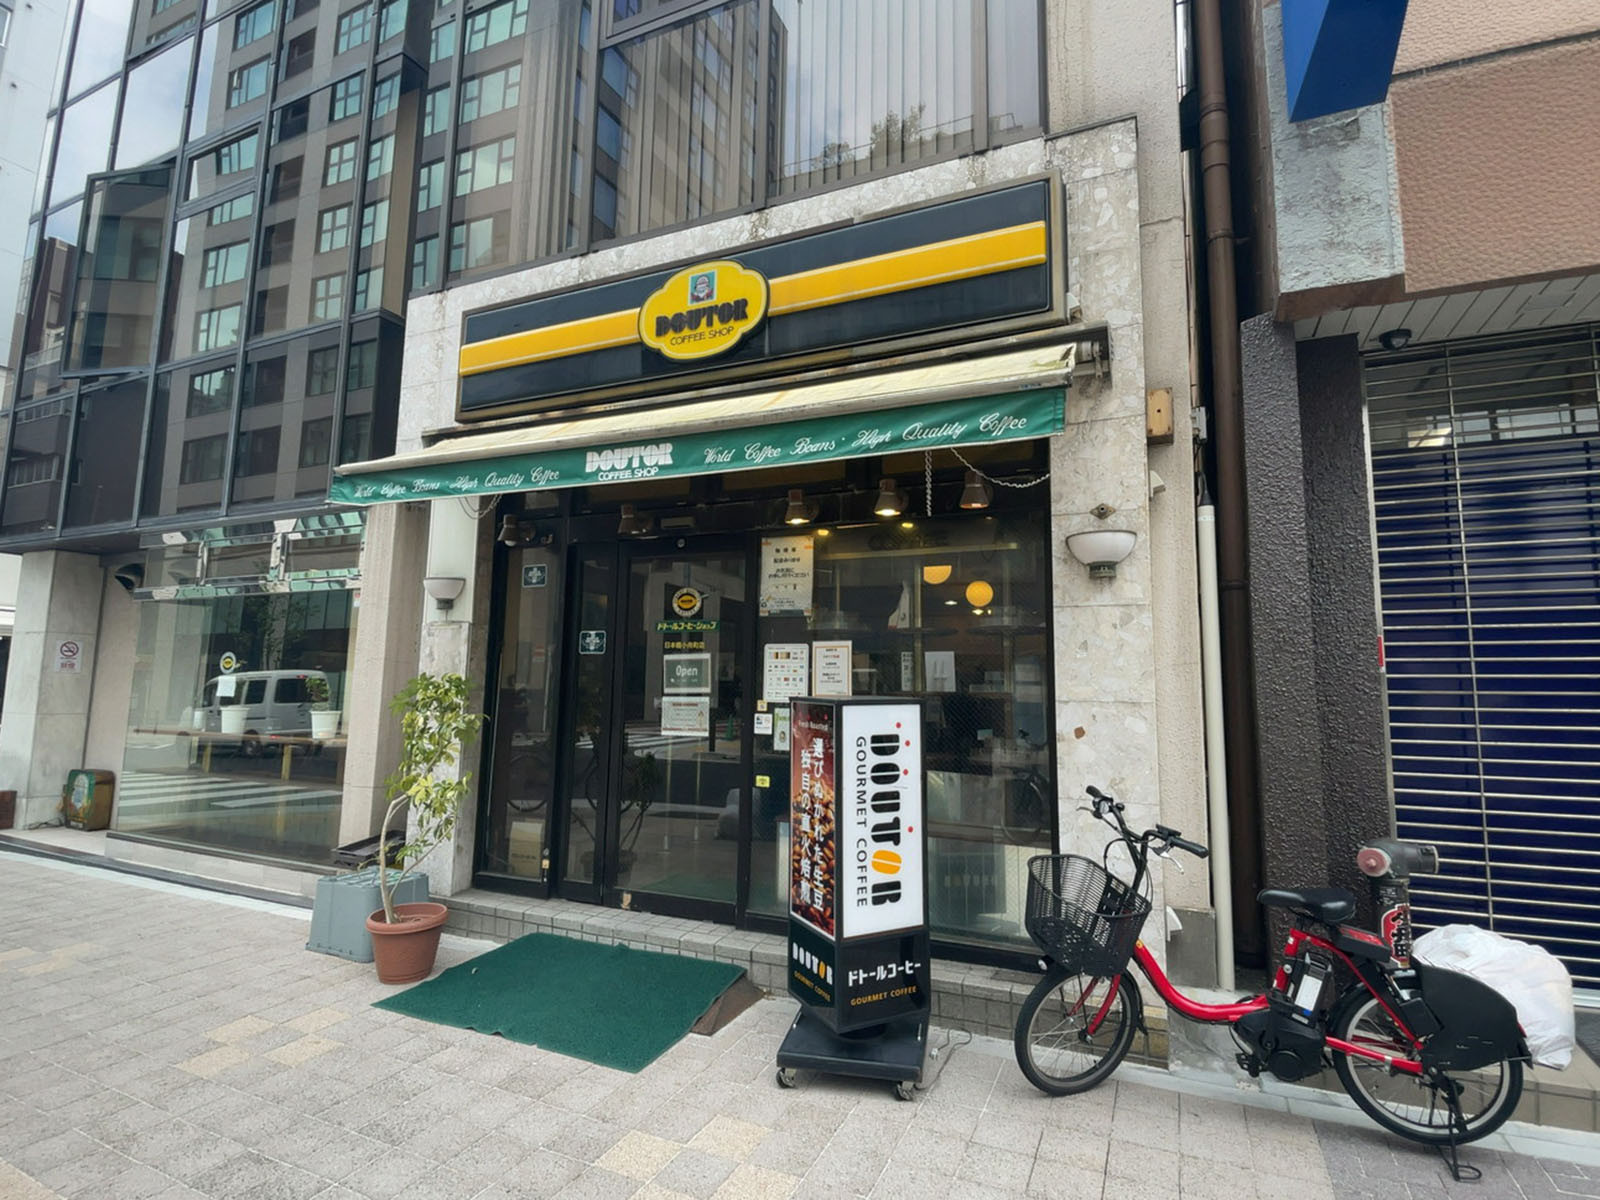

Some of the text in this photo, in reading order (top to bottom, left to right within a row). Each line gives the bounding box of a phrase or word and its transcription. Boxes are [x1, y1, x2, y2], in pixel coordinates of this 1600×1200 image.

[655, 298, 748, 338] DOUTOR
[670, 325, 735, 346] COFFEE SHOP
[704, 411, 1028, 464] World Coffee Beans High Quality Coffee
[585, 443, 673, 473] DOUTOR
[380, 482, 406, 496] Coffee
[411, 479, 441, 493] Beans
[484, 471, 524, 488] Quality
[530, 466, 560, 487] Coffee
[597, 467, 659, 482] COFFEE SHOP
[675, 664, 698, 678] Open
[856, 736, 868, 907] GOURMET COFFEE
[870, 733, 903, 906] DOUTOR
[792, 941, 834, 986] DOUTOR
[848, 959, 922, 988] ドトールコーヒー
[850, 985, 918, 1007] GOURMET COFFEE
